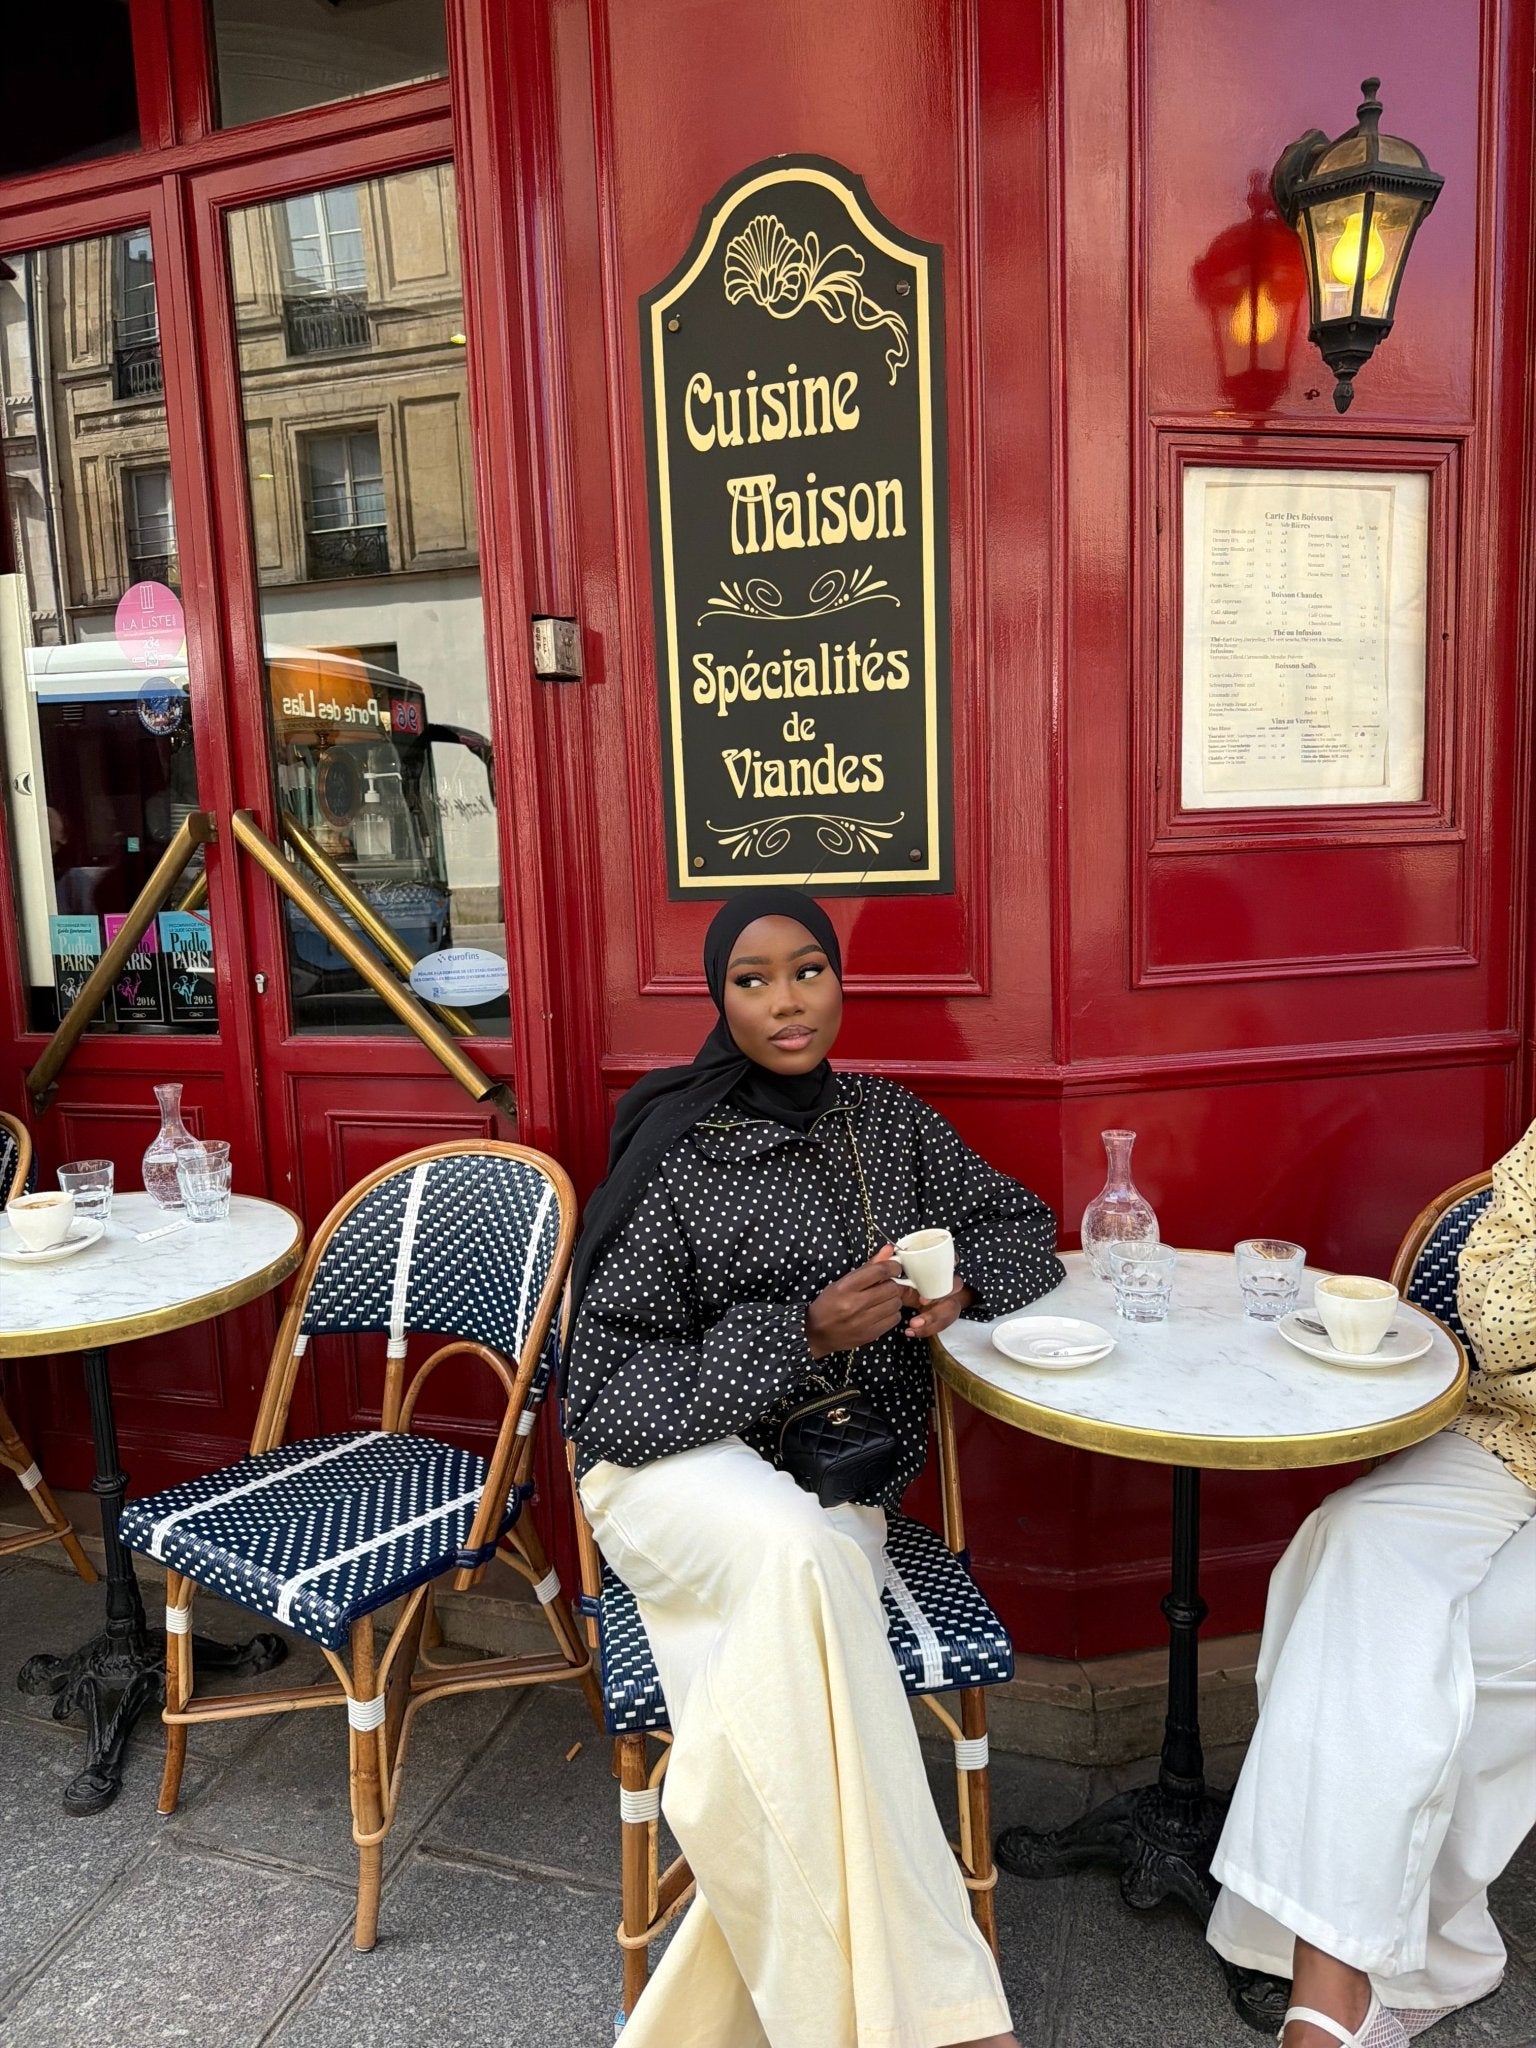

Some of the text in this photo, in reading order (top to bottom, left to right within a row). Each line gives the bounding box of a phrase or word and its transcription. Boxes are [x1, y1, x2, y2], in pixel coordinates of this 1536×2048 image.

[684, 363, 860, 452] Cuisine
[726, 472, 907, 555] Maison
[1264, 512, 1334, 522] Carte Des Boissons
[122, 619, 138, 630] LA
[141, 614, 172, 628] LISTE
[692, 638, 910, 717] Spécialités
[782, 711, 816, 743] de
[721, 743, 885, 799] Viandes
[58, 935, 94, 955] Pudlo
[170, 932, 207, 952] Pudlo
[60, 954, 95, 971] PARIS
[123, 952, 152, 970] ARIS
[172, 950, 210, 969] PARIS
[447, 952, 480, 962] eurofins
[136, 997, 156, 1006] 2016
[193, 995, 213, 1004] 2015
